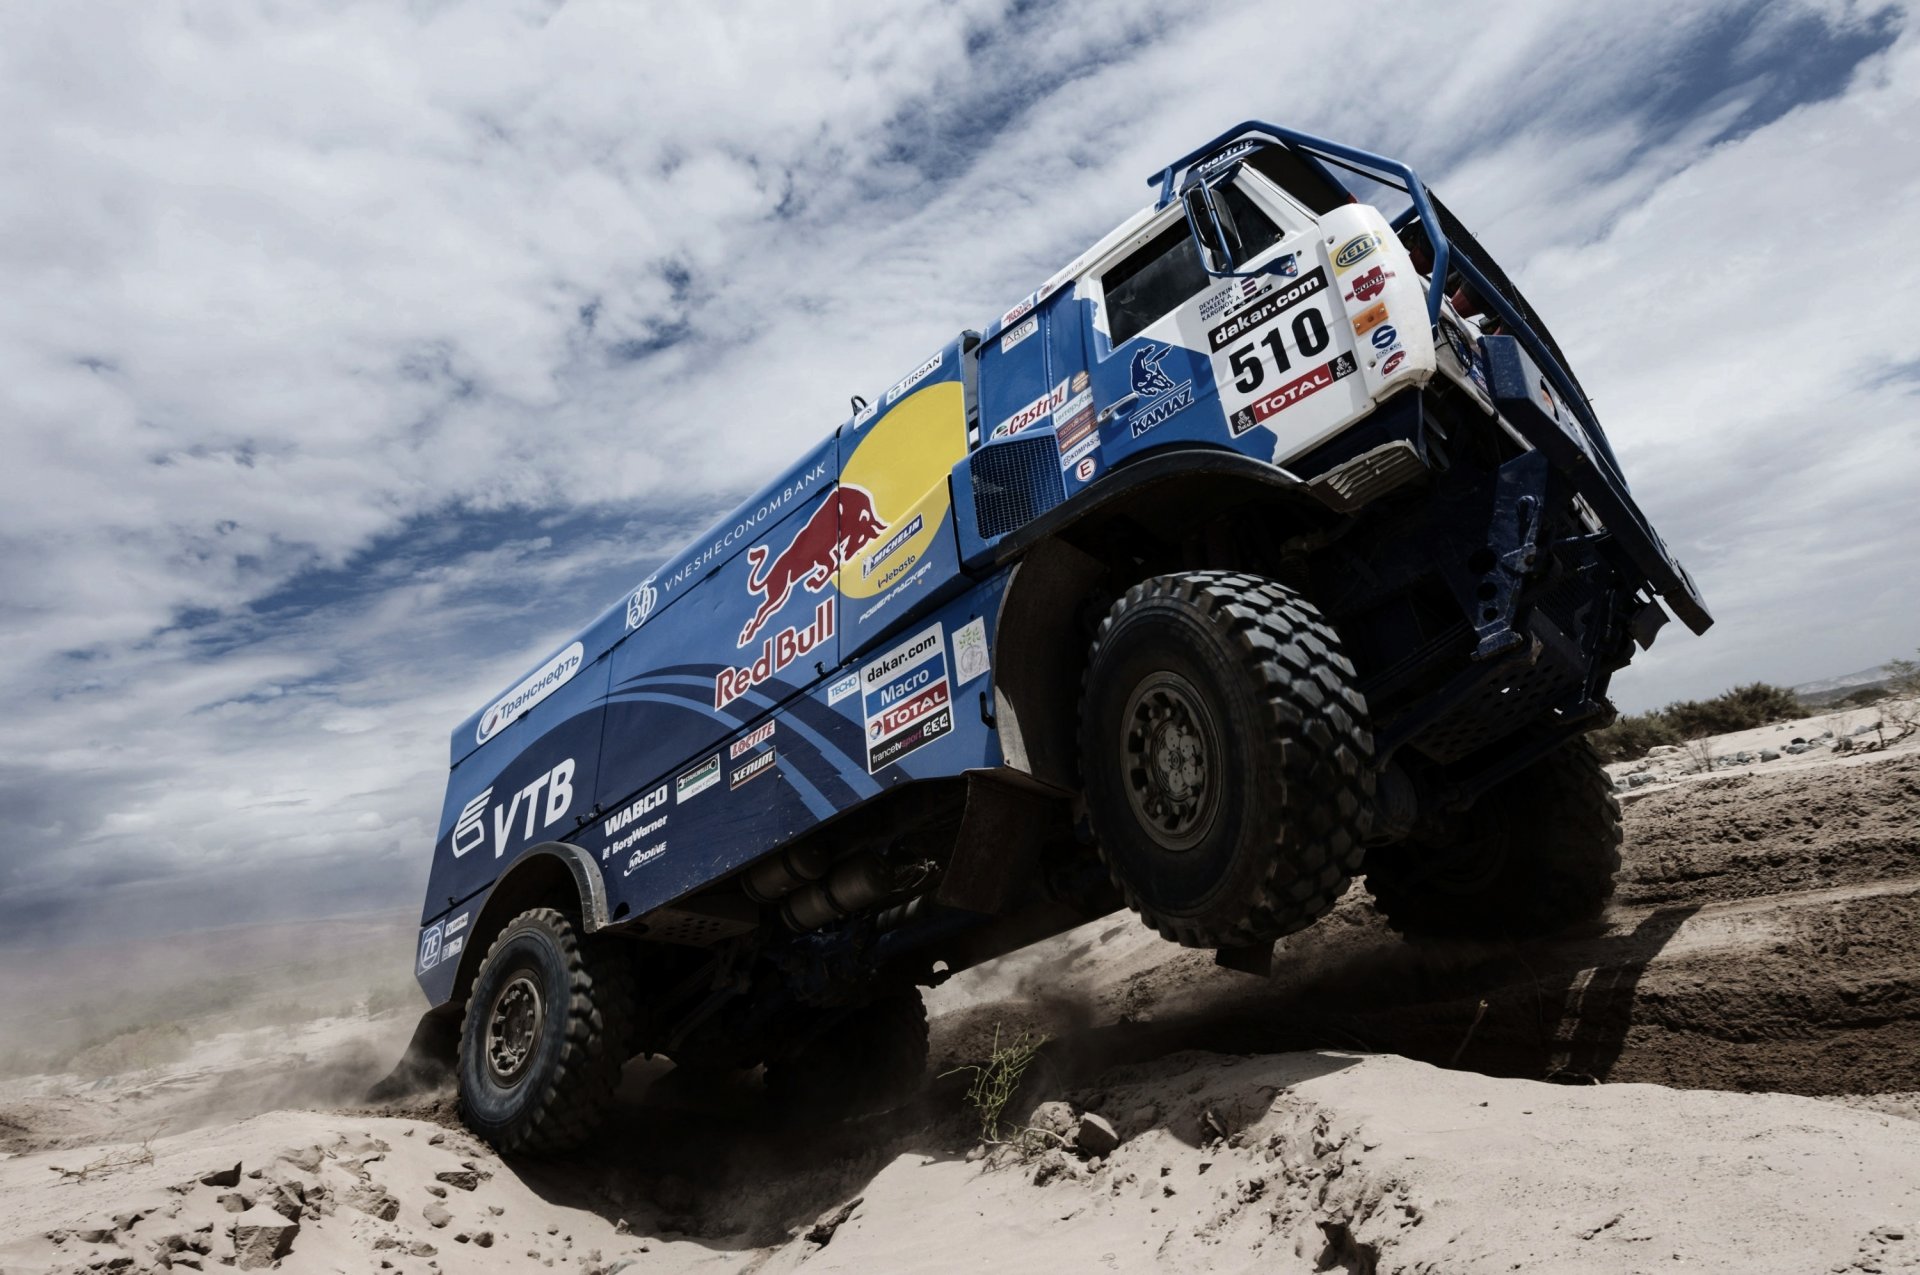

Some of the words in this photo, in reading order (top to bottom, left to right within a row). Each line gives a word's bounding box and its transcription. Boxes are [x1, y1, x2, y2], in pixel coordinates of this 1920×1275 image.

[1199, 286, 1233, 311] DEVYATKIN
[1200, 298, 1225, 317] MOKEEV
[1202, 301, 1234, 322] KARGINOV
[1215, 275, 1320, 344] dakar.com
[904, 357, 940, 388] TIRSAN
[1229, 308, 1330, 394] 510
[1010, 386, 1063, 435] Castrol
[1131, 387, 1194, 438] KAMAZ
[1256, 374, 1330, 414] TOTAL
[1081, 461, 1092, 478] E
[664, 462, 827, 592] VNESHECONOMBANK
[873, 518, 920, 565] MICHELIN
[715, 637, 773, 713] Red
[775, 595, 835, 673] Bull
[868, 635, 937, 682] dakar.com
[501, 656, 580, 720] Транснефть
[831, 676, 857, 697] TECHO
[880, 669, 929, 706] Macro
[886, 691, 946, 728] TOTAL
[732, 721, 773, 757] LOCTITE
[494, 758, 575, 859] VTB
[605, 784, 667, 837] WABCO
[612, 815, 668, 854] BorgWarner
